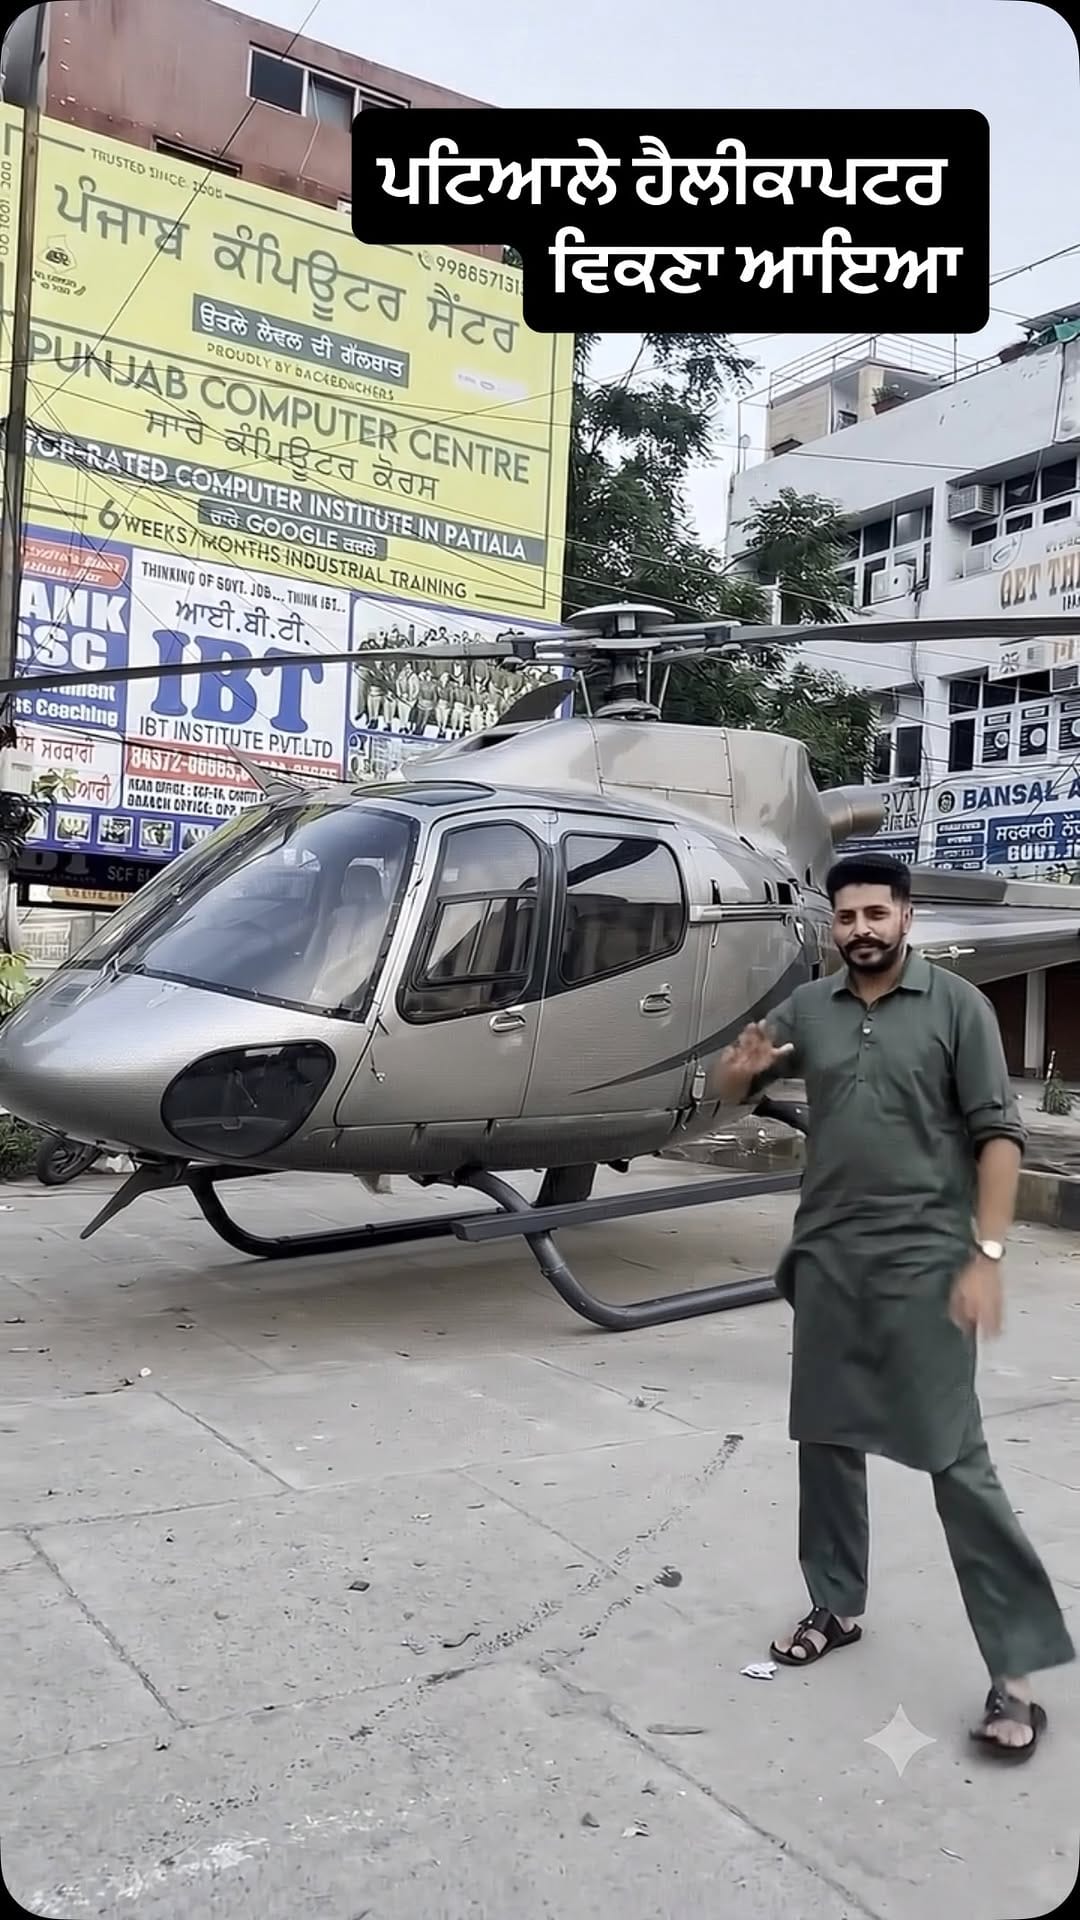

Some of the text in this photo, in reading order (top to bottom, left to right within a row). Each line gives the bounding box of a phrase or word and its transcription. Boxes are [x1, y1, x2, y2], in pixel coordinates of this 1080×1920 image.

[91, 148, 146, 174] TRUSTED
[54, 175, 190, 260] ਪੰਜਾਬ
[213, 225, 407, 322] ਕੰਪਿਊਟਰ
[427, 282, 520, 353] ਸੈਂਟਰ
[436, 255, 523, 296] 998857131
[207, 342, 270, 369] PROUDLY
[311, 334, 334, 359] ਦੀ
[30, 331, 530, 485] PUNJAB COMPUTER CENTRE
[372, 453, 440, 500] ਕੋਰਸ
[175, 467, 303, 513] COMPUTER
[309, 494, 413, 540] INSTITUTE
[418, 519, 439, 543] IN
[444, 522, 526, 561] PATIALA
[246, 513, 338, 551] GOOGLE
[141, 561, 195, 586] THINKING
[199, 573, 214, 588] OF
[286, 548, 385, 584] INDUSTRIAL
[390, 569, 467, 599] TRAINING
[19, 579, 128, 634] ANK
[151, 629, 324, 734] IBT
[139, 716, 168, 739] IBT
[174, 722, 263, 752] INSTITUTE
[962, 780, 1059, 811] BANSAL
